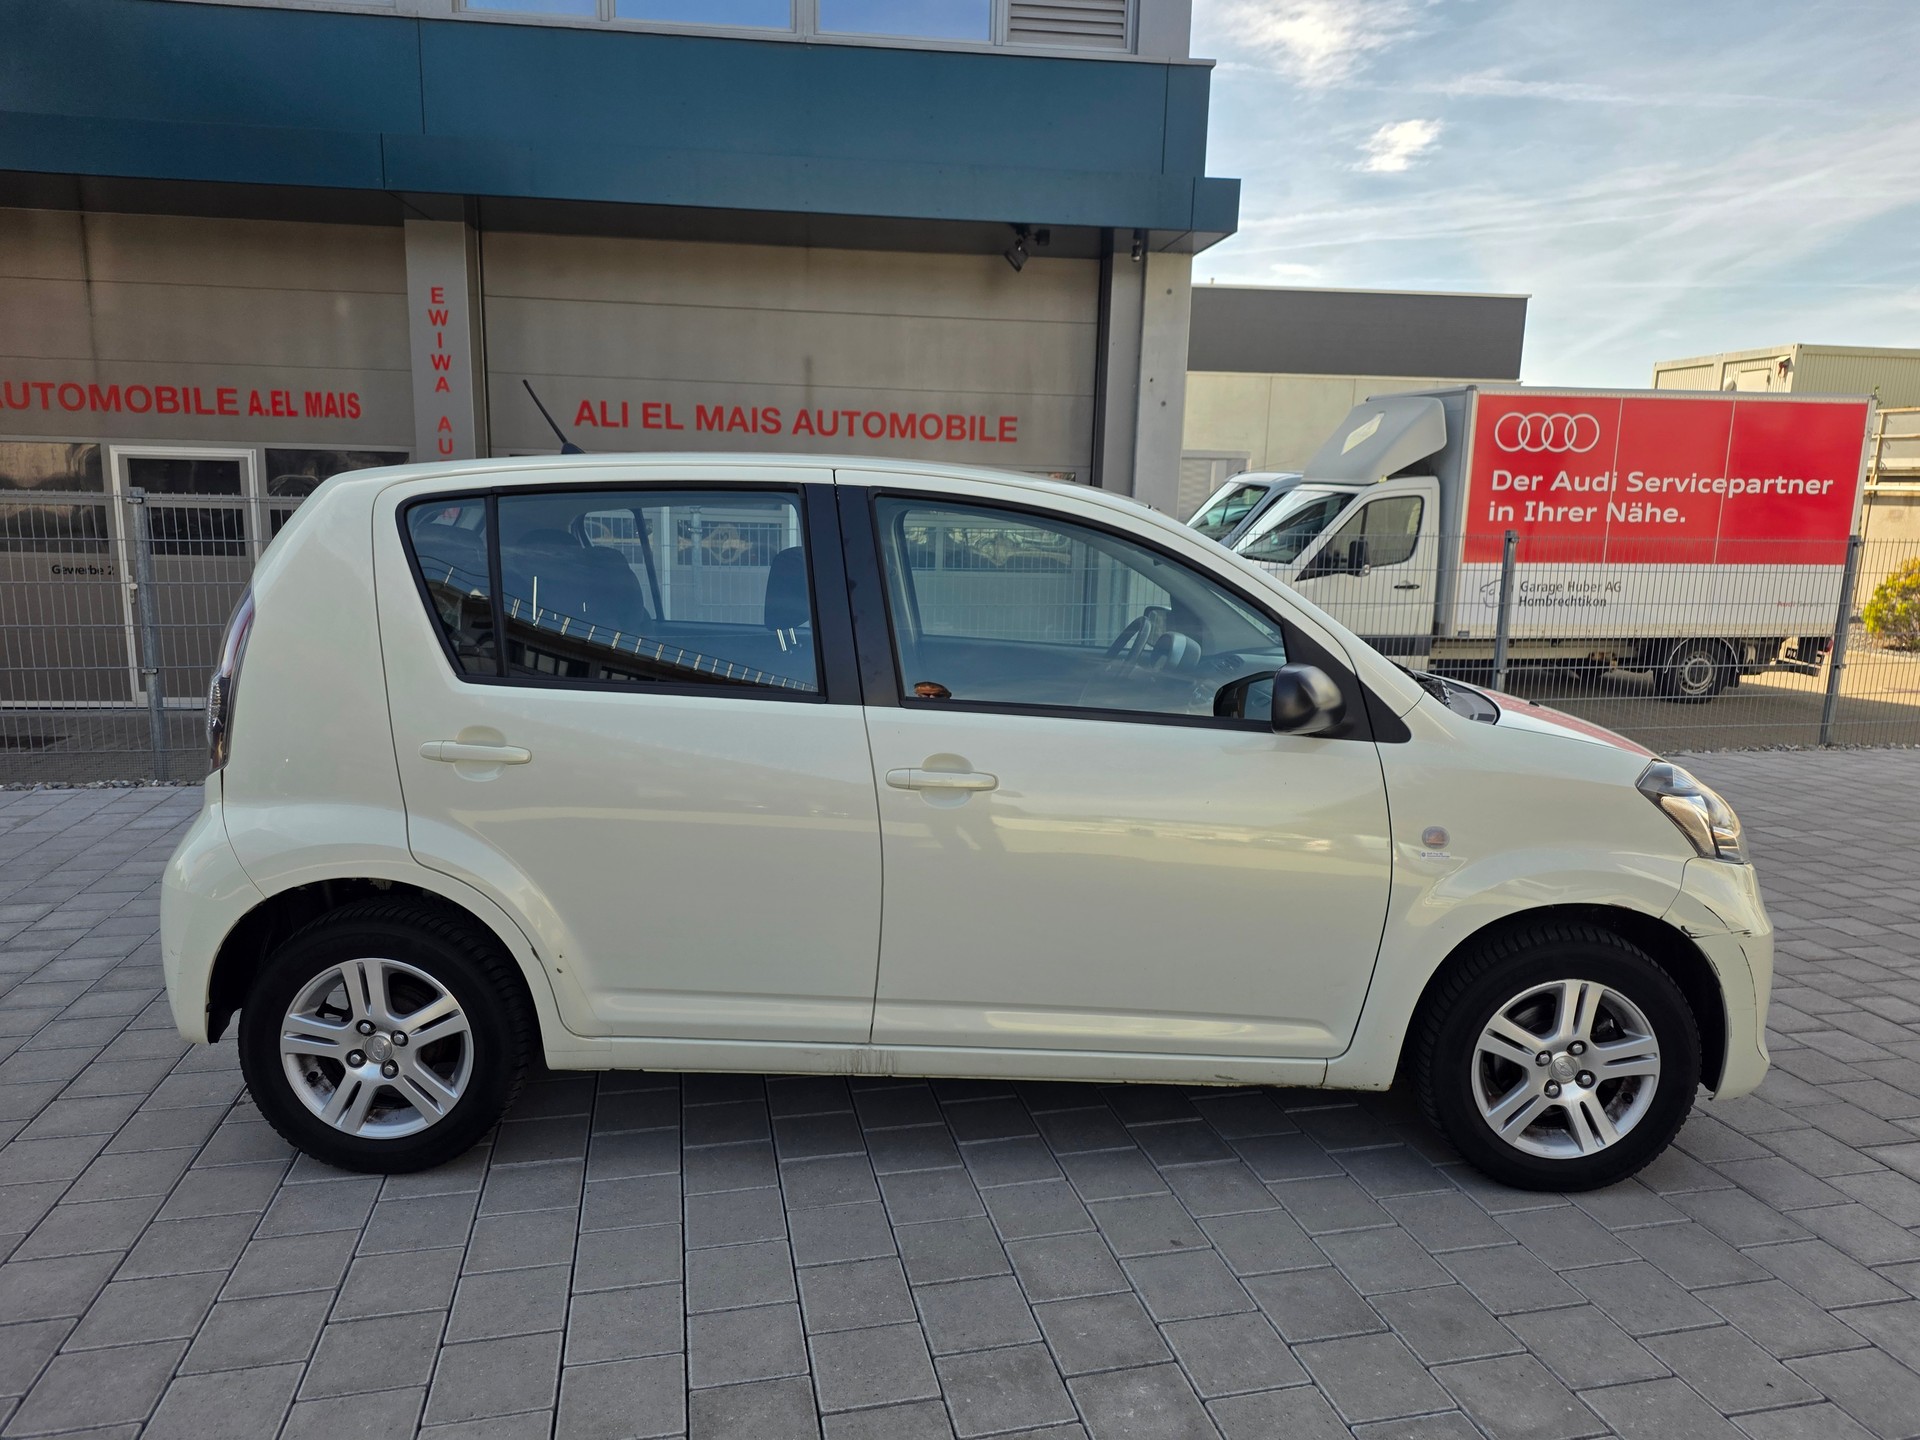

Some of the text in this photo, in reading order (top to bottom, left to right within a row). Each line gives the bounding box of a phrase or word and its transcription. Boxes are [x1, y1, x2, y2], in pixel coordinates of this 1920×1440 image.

[428, 287, 454, 461] EWIWA AU
[0, 381, 240, 416] UTOMOBILE
[304, 391, 362, 419] MAIS
[574, 400, 1018, 443] ALI EL MAIS AUTOMOBILE
[1491, 469, 1834, 499] Der Audi Servicepartner
[1488, 501, 1687, 524] in Ihrer Nähe.
[51, 564, 104, 576] Gewerbe
[1518, 595, 1607, 607] Hombrechtikon
[1520, 581, 1622, 595] Garage Huber AG
